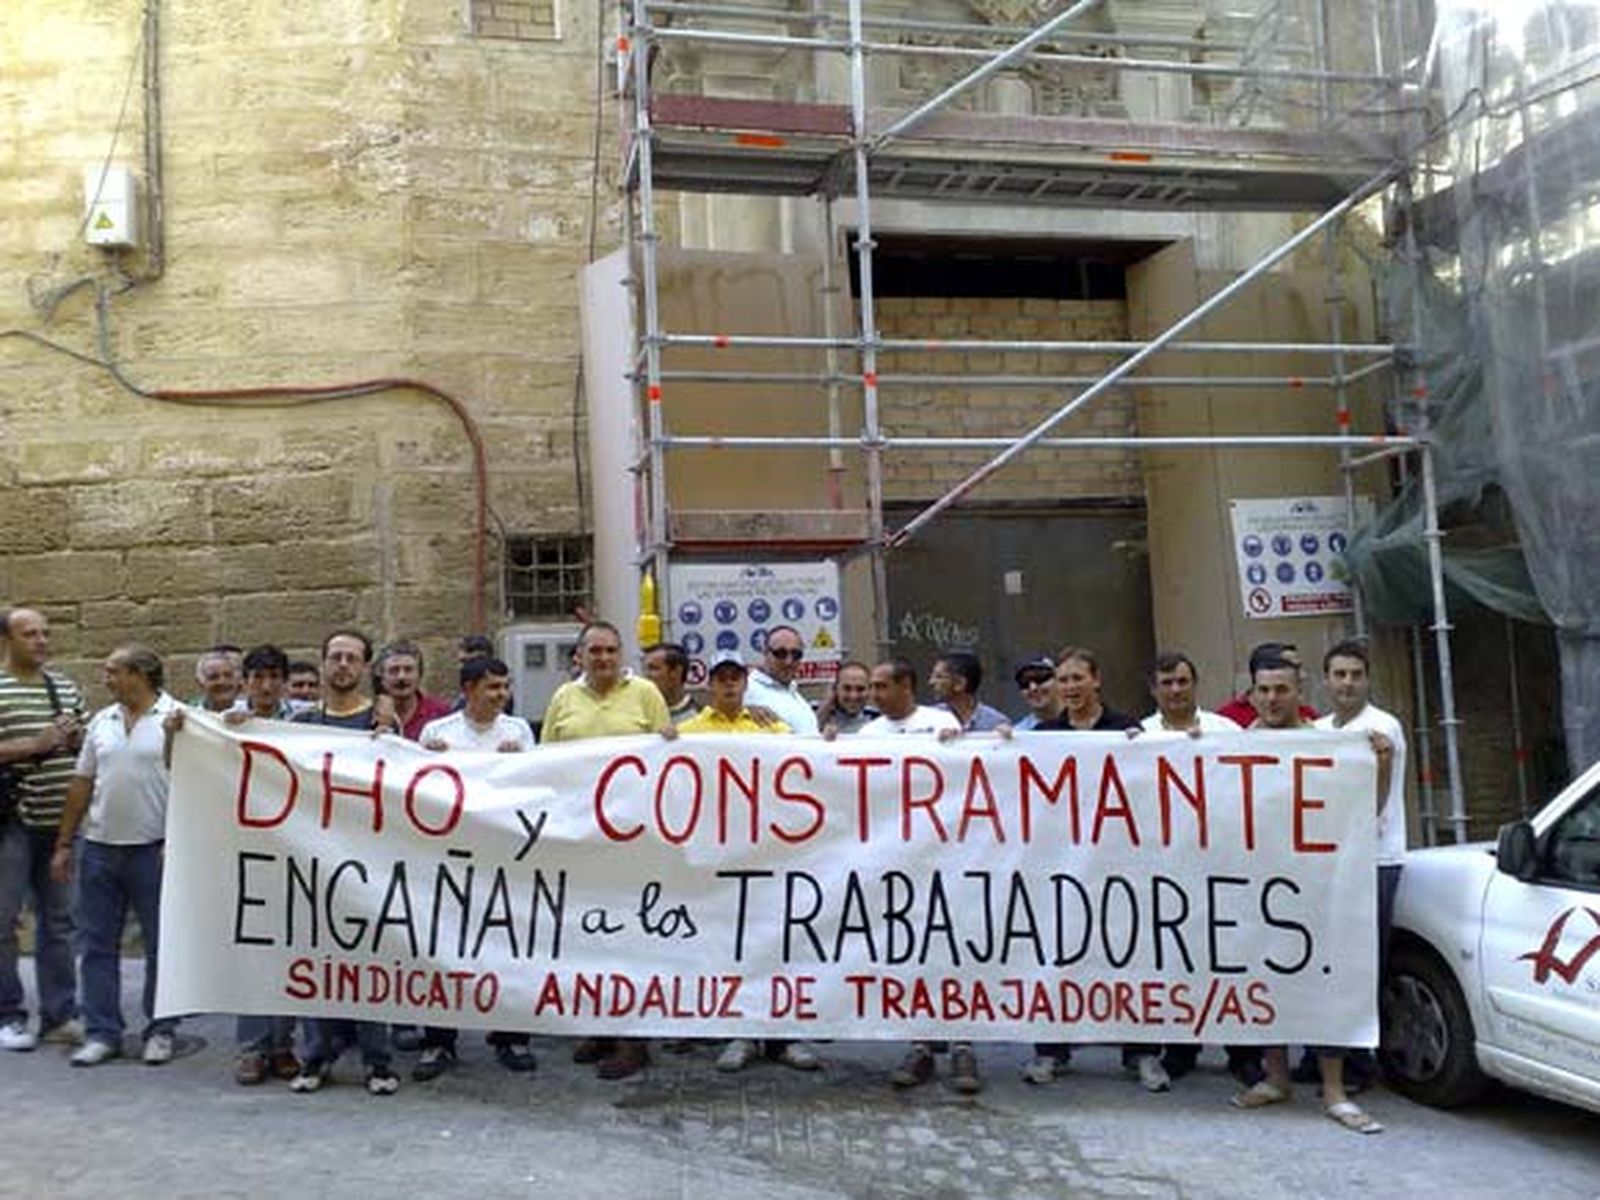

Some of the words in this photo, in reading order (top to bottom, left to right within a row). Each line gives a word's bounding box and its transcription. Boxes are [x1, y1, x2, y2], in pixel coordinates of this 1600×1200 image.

[235, 740, 467, 836] DHO
[515, 809, 548, 862] y
[593, 753, 1339, 854] CONSTRAMANTE
[233, 848, 568, 960] ENGAÑAN
[580, 907, 625, 935] a
[636, 881, 699, 938] los
[715, 869, 1333, 975] TRABAJADORES.
[533, 971, 745, 1020] ANDALUZ
[769, 975, 819, 1020] DE
[845, 975, 1277, 1037] TRABAJADORES/AS
